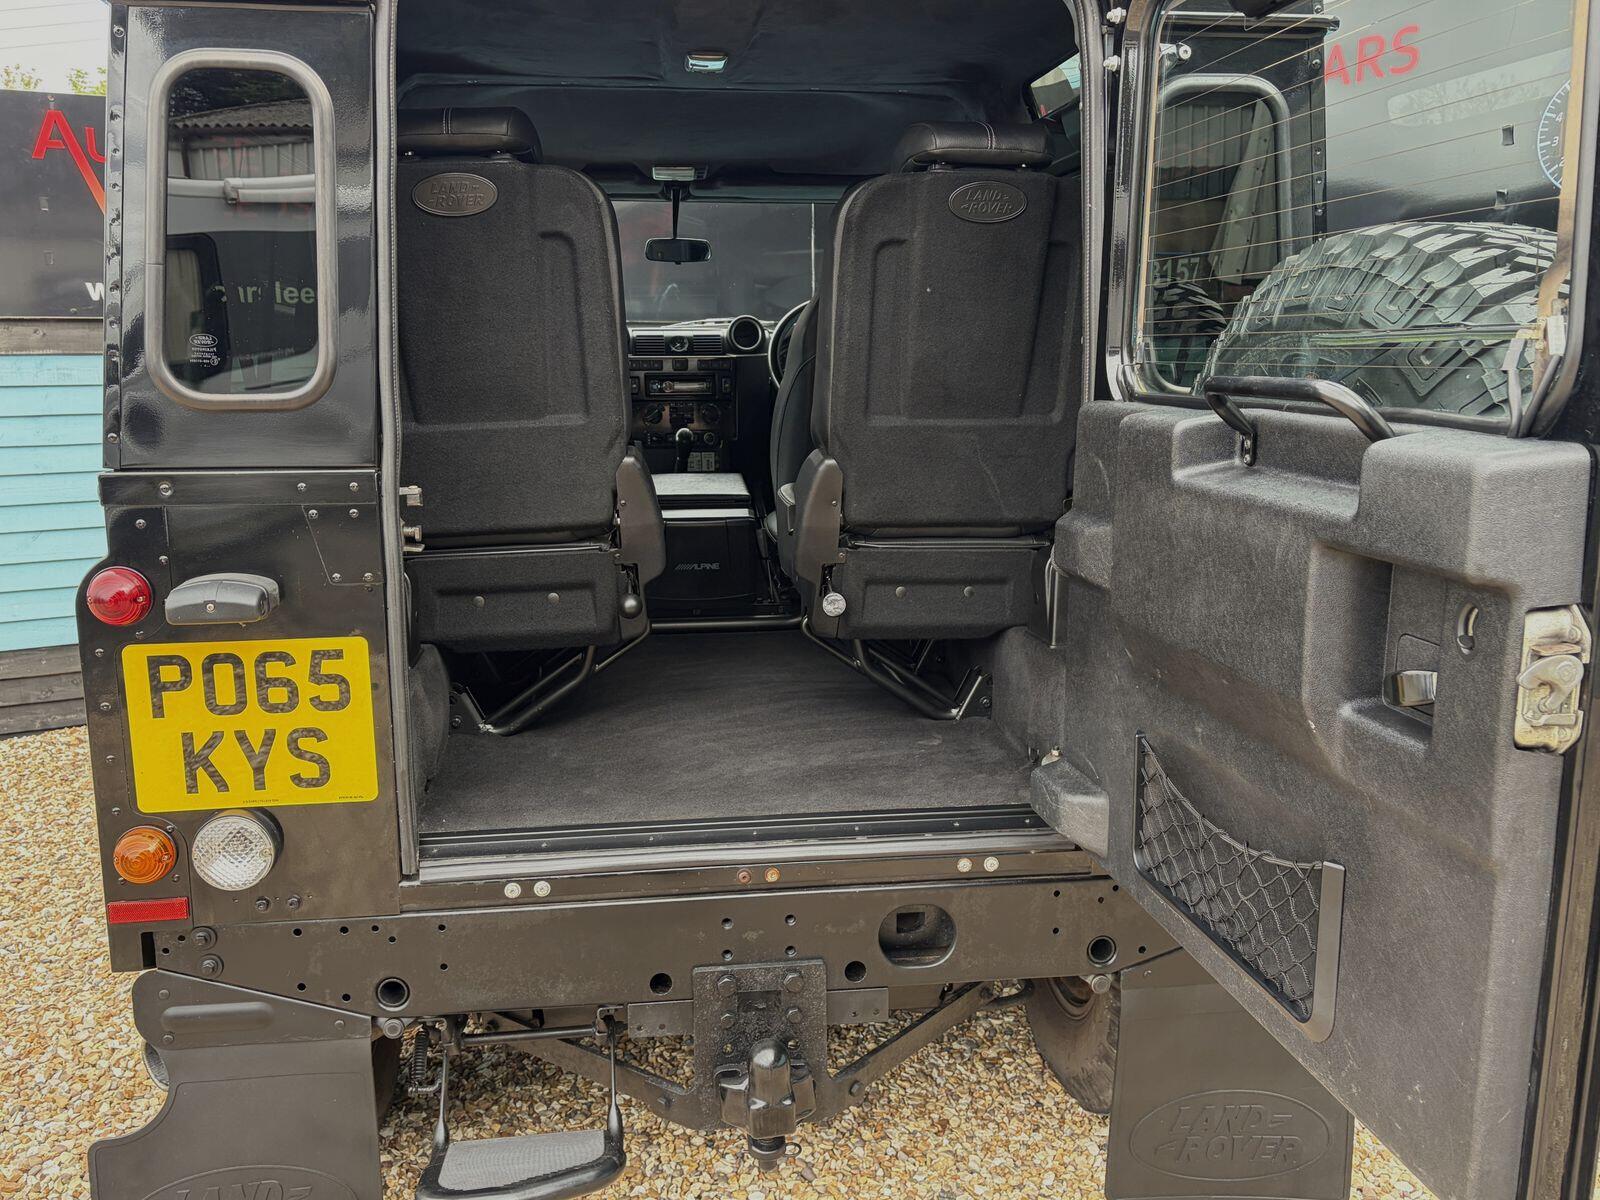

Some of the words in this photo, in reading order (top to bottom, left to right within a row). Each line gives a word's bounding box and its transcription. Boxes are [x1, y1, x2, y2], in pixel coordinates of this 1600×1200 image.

[431, 181, 469, 194] LAND
[966, 189, 1001, 201] LAND
[435, 193, 485, 207] ROVER
[968, 202, 1013, 214] ROVER
[146, 649, 351, 718] PO65
[181, 727, 331, 794] KYS
[1169, 1105, 1266, 1135] LAND
[1175, 1136, 1303, 1164] ROVER
